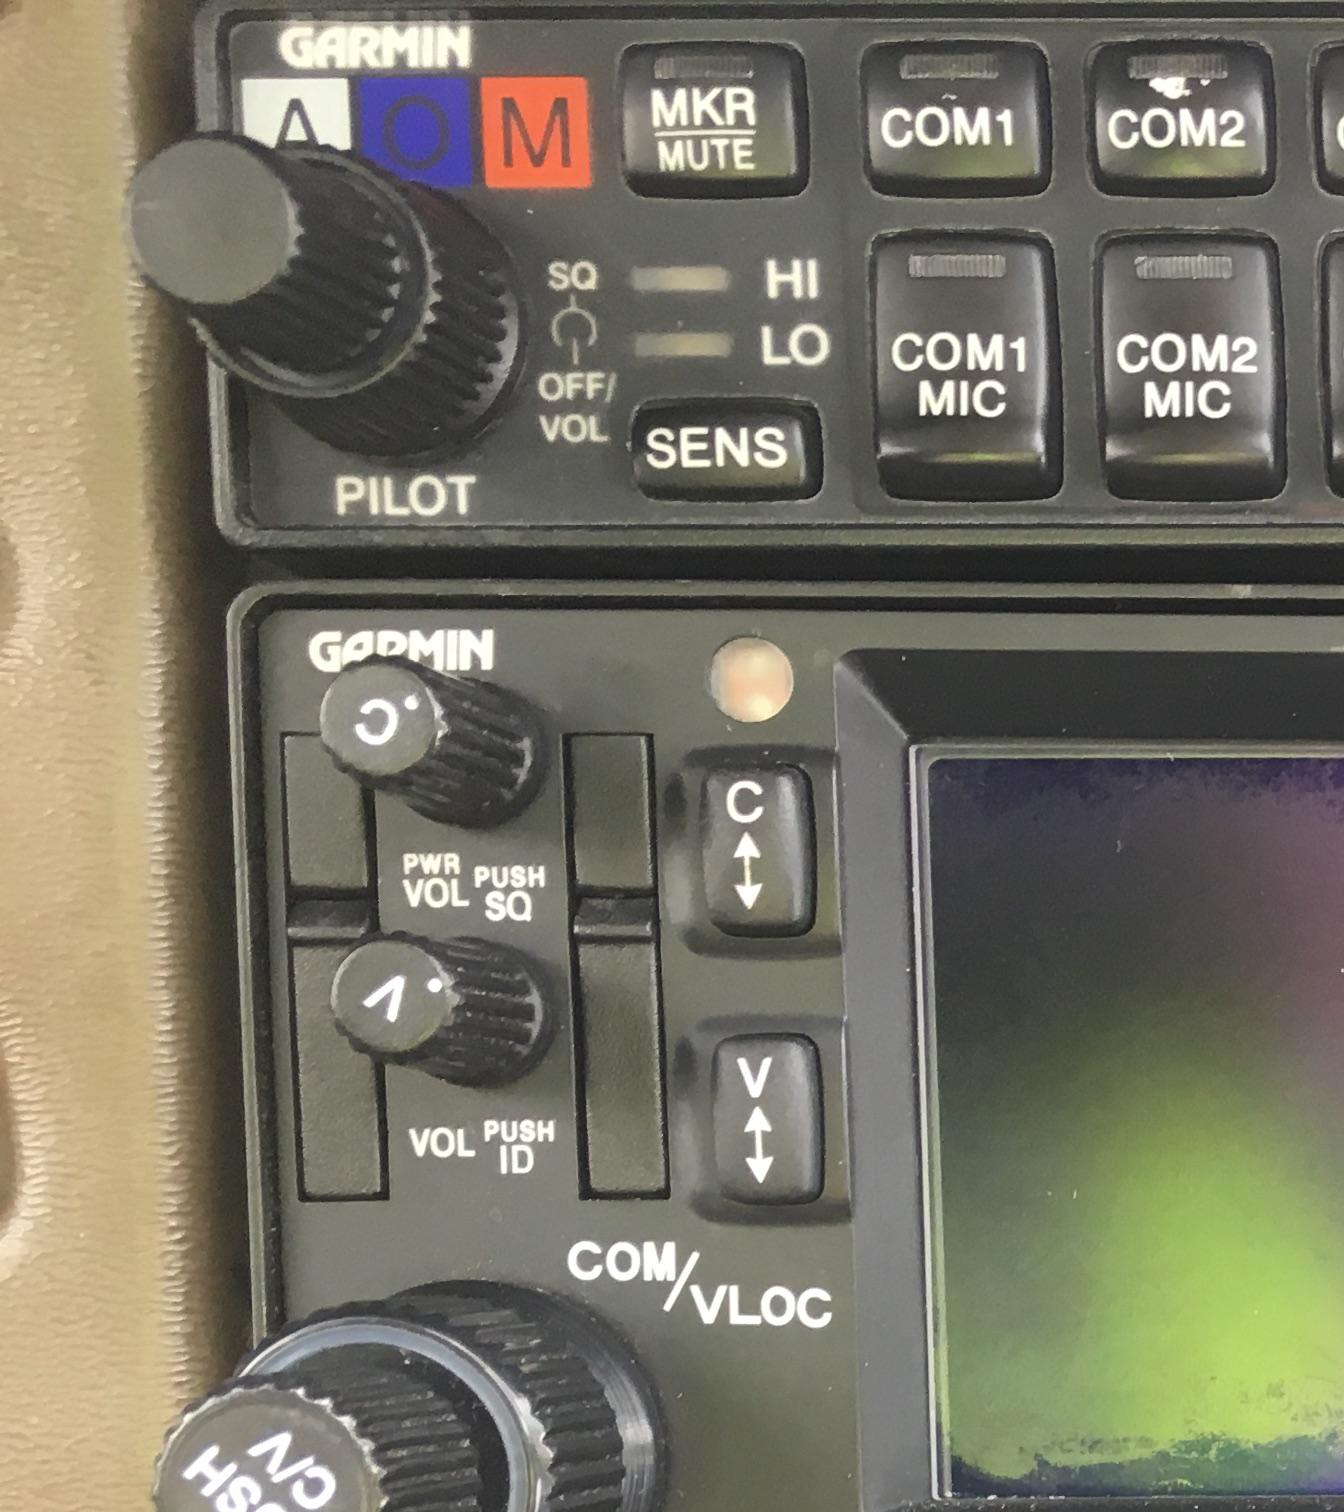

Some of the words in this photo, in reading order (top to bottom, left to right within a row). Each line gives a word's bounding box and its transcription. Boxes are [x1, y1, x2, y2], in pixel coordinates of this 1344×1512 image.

[278, 20, 472, 70] GARMIN
[651, 86, 757, 128] MKR
[880, 106, 1013, 149] COM1
[378, 92, 450, 172] O
[500, 94, 572, 170] M
[1107, 107, 1246, 150] COM2
[657, 137, 756, 171] MUTE
[548, 260, 599, 292] SQ
[766, 258, 819, 300] HI
[761, 322, 831, 366] LO
[891, 331, 1026, 373] COM1
[1116, 332, 1259, 374] COM2
[537, 371, 617, 403] OFF/
[918, 379, 1007, 418] MIC
[1144, 379, 1232, 419] MIC
[539, 413, 609, 444] VOL
[646, 426, 788, 469] SENS
[335, 474, 477, 517] PILOT
[726, 780, 764, 824] C
[403, 852, 461, 875] PWR
[473, 864, 546, 890] PUSH
[402, 877, 470, 909] VOL
[484, 889, 533, 922] SQ
[736, 1056, 773, 1099] V
[408, 1126, 476, 1158] VOL
[483, 1119, 555, 1143] PUSH
[499, 1143, 535, 1175] ID
